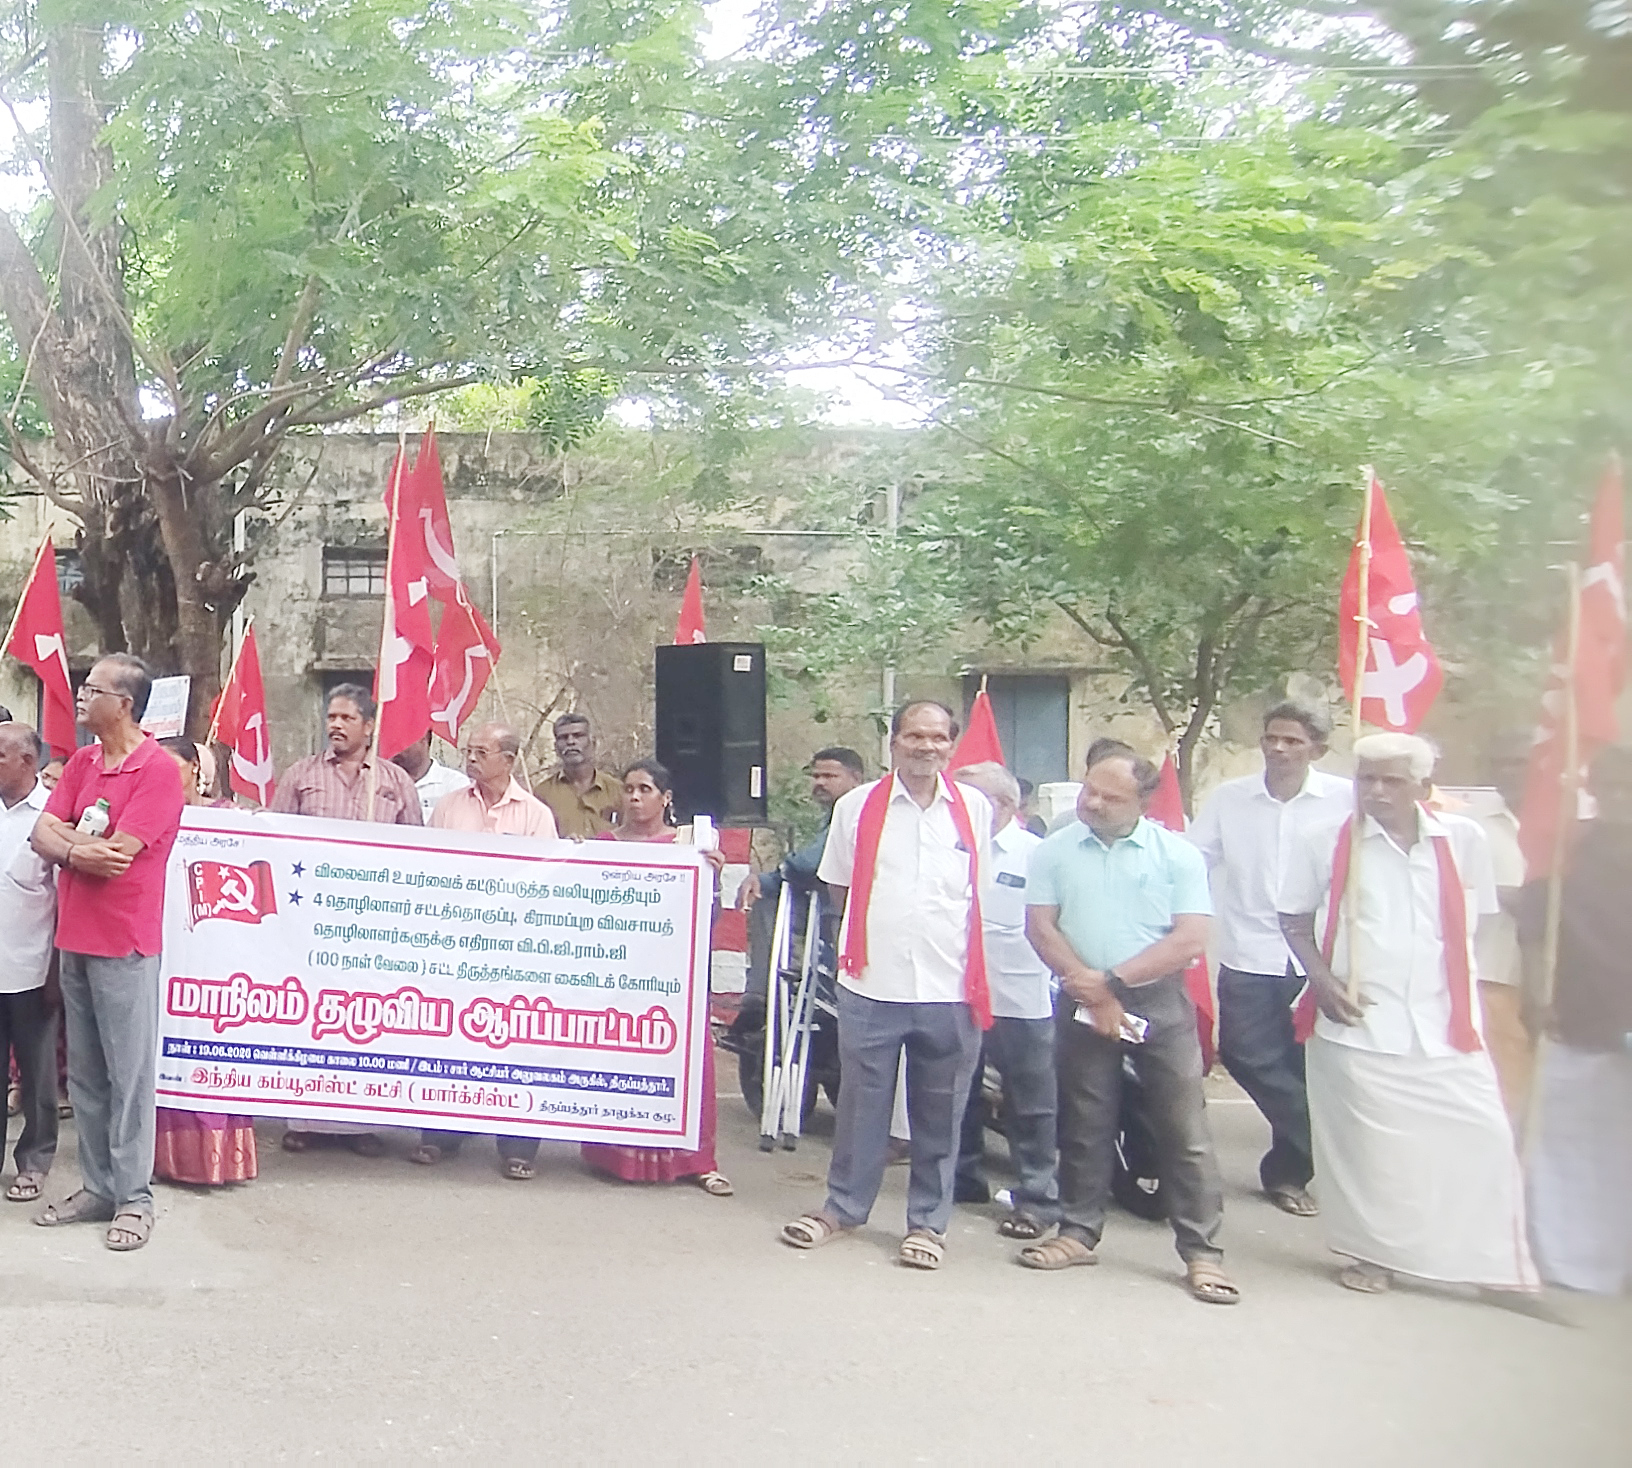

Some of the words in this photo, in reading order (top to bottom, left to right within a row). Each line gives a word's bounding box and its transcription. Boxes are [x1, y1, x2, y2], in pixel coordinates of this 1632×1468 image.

[314, 863, 389, 884] விலைவாசி
[392, 870, 463, 890] உயர்வைக்
[466, 876, 550, 899] கட்டுப்படுத்த
[553, 883, 661, 906] வலியுறுத்தியும்
[601, 870, 641, 882] ஒன்றிய
[643, 872, 676, 883] அரசே
[313, 892, 323, 906] 4
[326, 894, 411, 915] தொழிலாளர்
[524, 909, 594, 932] கிராமப்புற
[597, 915, 674, 937] விவசாயத்
[313, 923, 456, 949] தொழிலாளர்களுக்கு
[459, 934, 513, 951] எதிரான
[341, 953, 371, 971] நாள்
[429, 962, 454, 976] சட்ட
[456, 962, 551, 983] திருத்தங்களை
[554, 972, 616, 990] கைவிடக்
[618, 974, 682, 997] கோரியும்
[168, 974, 308, 1032] மாநிலம்
[313, 987, 452, 1043] தழுவிய
[460, 996, 676, 1053] ஆர்ப்பாட்டம்
[358, 1056, 386, 1069] 10.00
[190, 1066, 251, 1089] இந்திய
[257, 1071, 357, 1096] கம்யூனிஸ்ட்
[364, 1080, 402, 1099] கட்சி
[422, 1083, 521, 1107] மார்க்சிஸ்ட்
